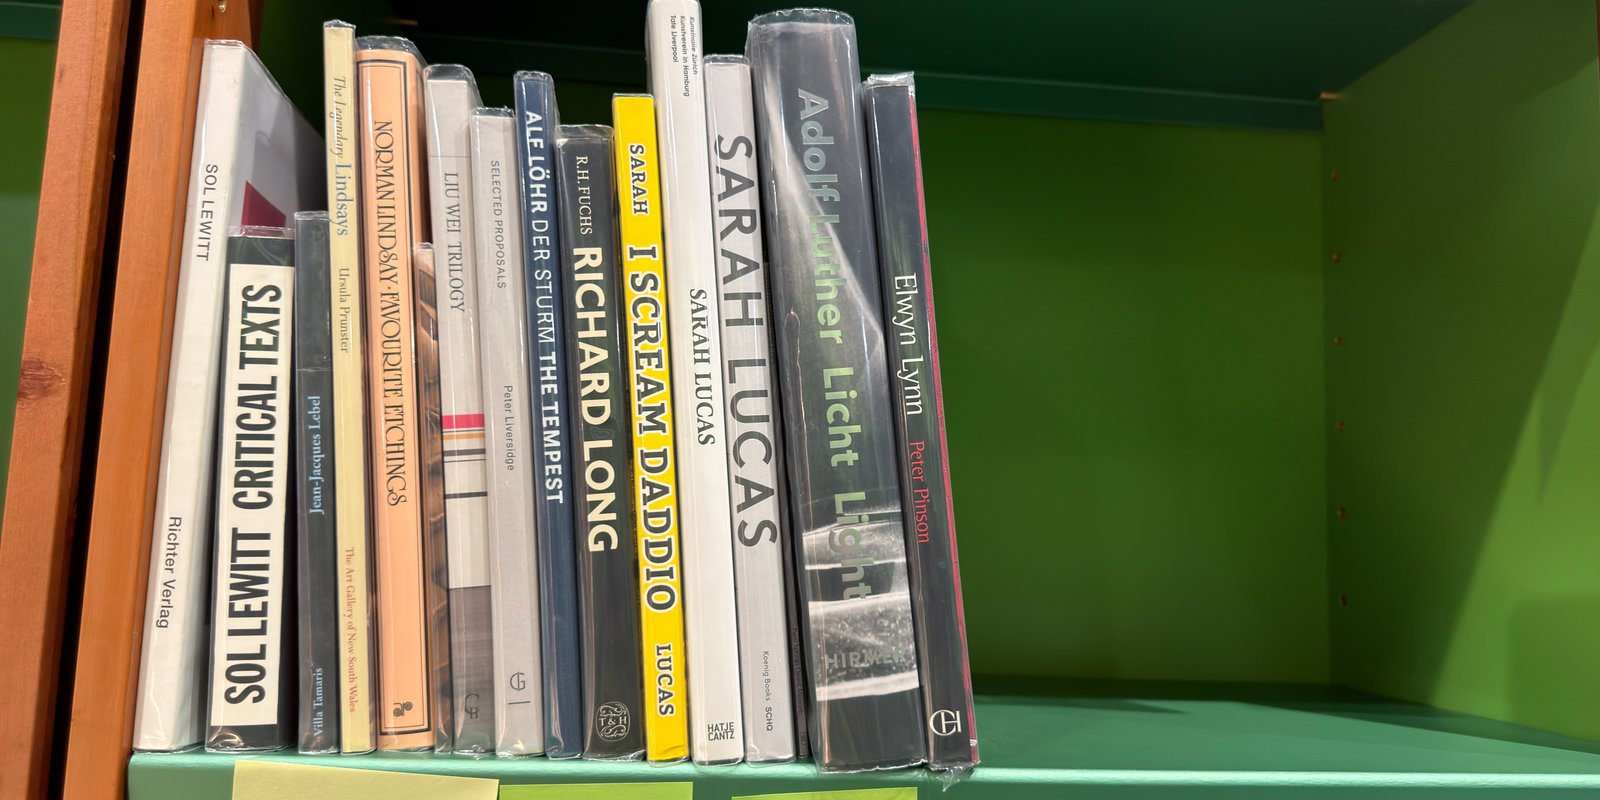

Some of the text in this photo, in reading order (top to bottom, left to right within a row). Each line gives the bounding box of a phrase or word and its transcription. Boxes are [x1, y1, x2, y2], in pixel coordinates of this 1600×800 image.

[671, 31, 679, 62] Liverpool
[196, 164, 218, 262] SOL LEWITT
[329, 76, 352, 236] The Legendary Lindsays
[576, 156, 592, 236] R.H. FUCHS
[444, 172, 465, 312] LIU WEI TRILOGY
[490, 160, 506, 289] SELECTED PROPOSALS
[338, 268, 350, 354] Ursula Prunster
[374, 120, 407, 506] NORMAN LINDSAY FAVOURITE ETCHINGS
[525, 110, 564, 504] ALF LÖHR DER STURM THE TEMPEST
[690, 288, 716, 446] SARAH LUCAS
[715, 135, 778, 548] SARAH LUCAS
[798, 88, 874, 600] Adolf Luther Licht Light
[892, 273, 924, 416] Elwyn Lynn
[307, 396, 324, 514] Jean-Jacques Lebel
[504, 385, 515, 471] Peter Liversidge
[573, 247, 619, 552] RICHARD LONG
[628, 144, 678, 716] SARAH I SCREAM DADDIO LUCAS
[224, 284, 282, 705] SOL LEWITT CRITICAL TEXTS
[910, 440, 930, 544] Peter Pinson
[156, 516, 182, 630] Richter Verlag
[344, 547, 358, 712] The Art Gallery of New South Wales
[312, 667, 324, 737] Villa Tamaris
[826, 649, 905, 670] HIRMER
[708, 722, 736, 742] HATJE CANTZ
